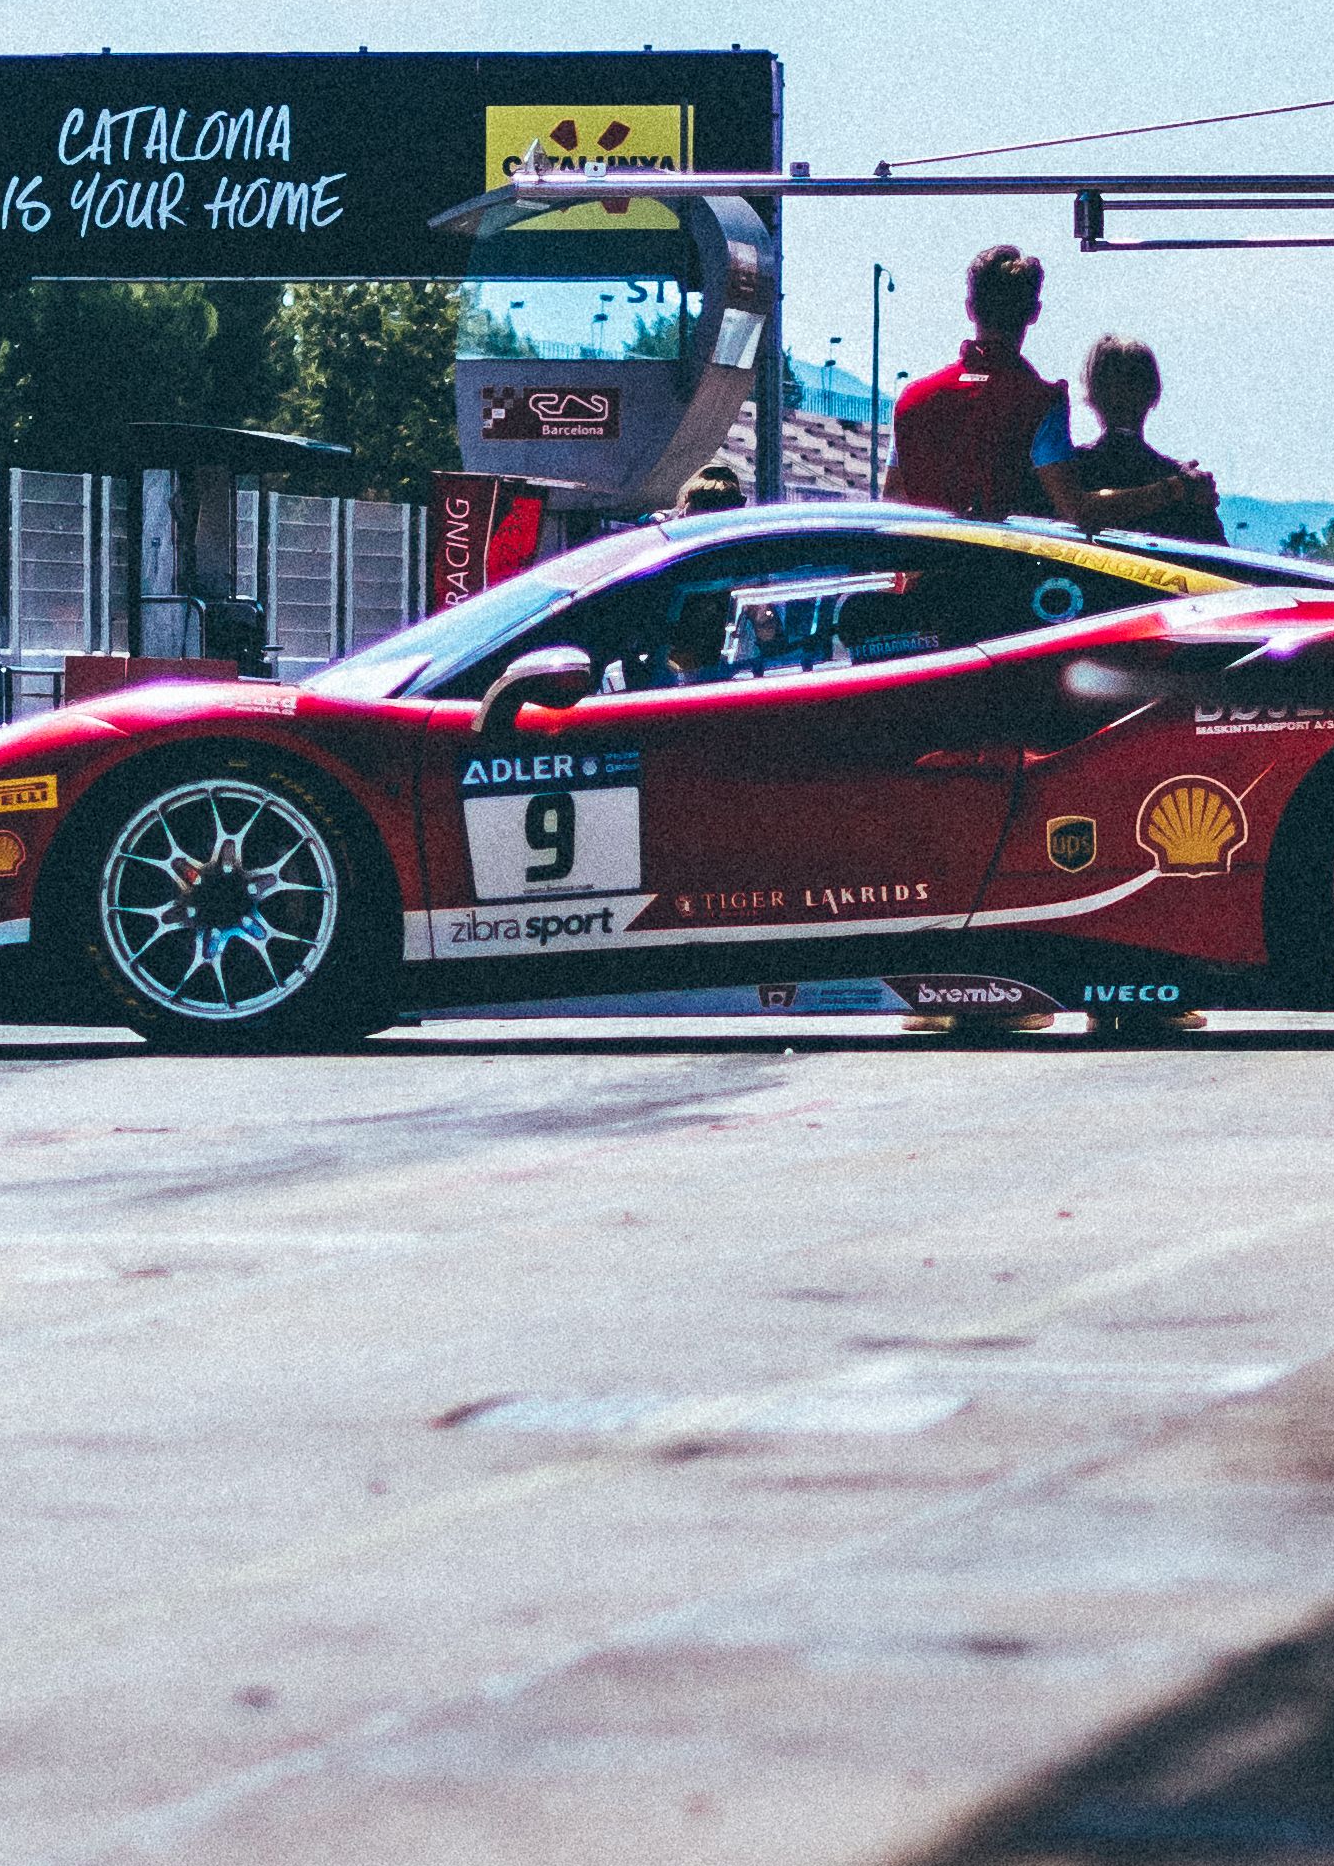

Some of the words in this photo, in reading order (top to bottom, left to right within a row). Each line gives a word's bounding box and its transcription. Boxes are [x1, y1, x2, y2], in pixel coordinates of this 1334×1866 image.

[58, 104, 291, 166] CATALONIA
[1, 175, 52, 232] IS
[70, 171, 188, 238] YOUR
[203, 172, 348, 233] HOME
[541, 424, 605, 437] Barcelona
[444, 496, 472, 607] RACING
[461, 754, 575, 786] ADLER
[524, 791, 576, 883] 9
[1052, 835, 1093, 862] ups
[701, 890, 787, 911] TIGER
[804, 882, 930, 915] LAKRIDS
[917, 981, 1023, 1004] brembo
[1083, 984, 1181, 1002] IVECO
